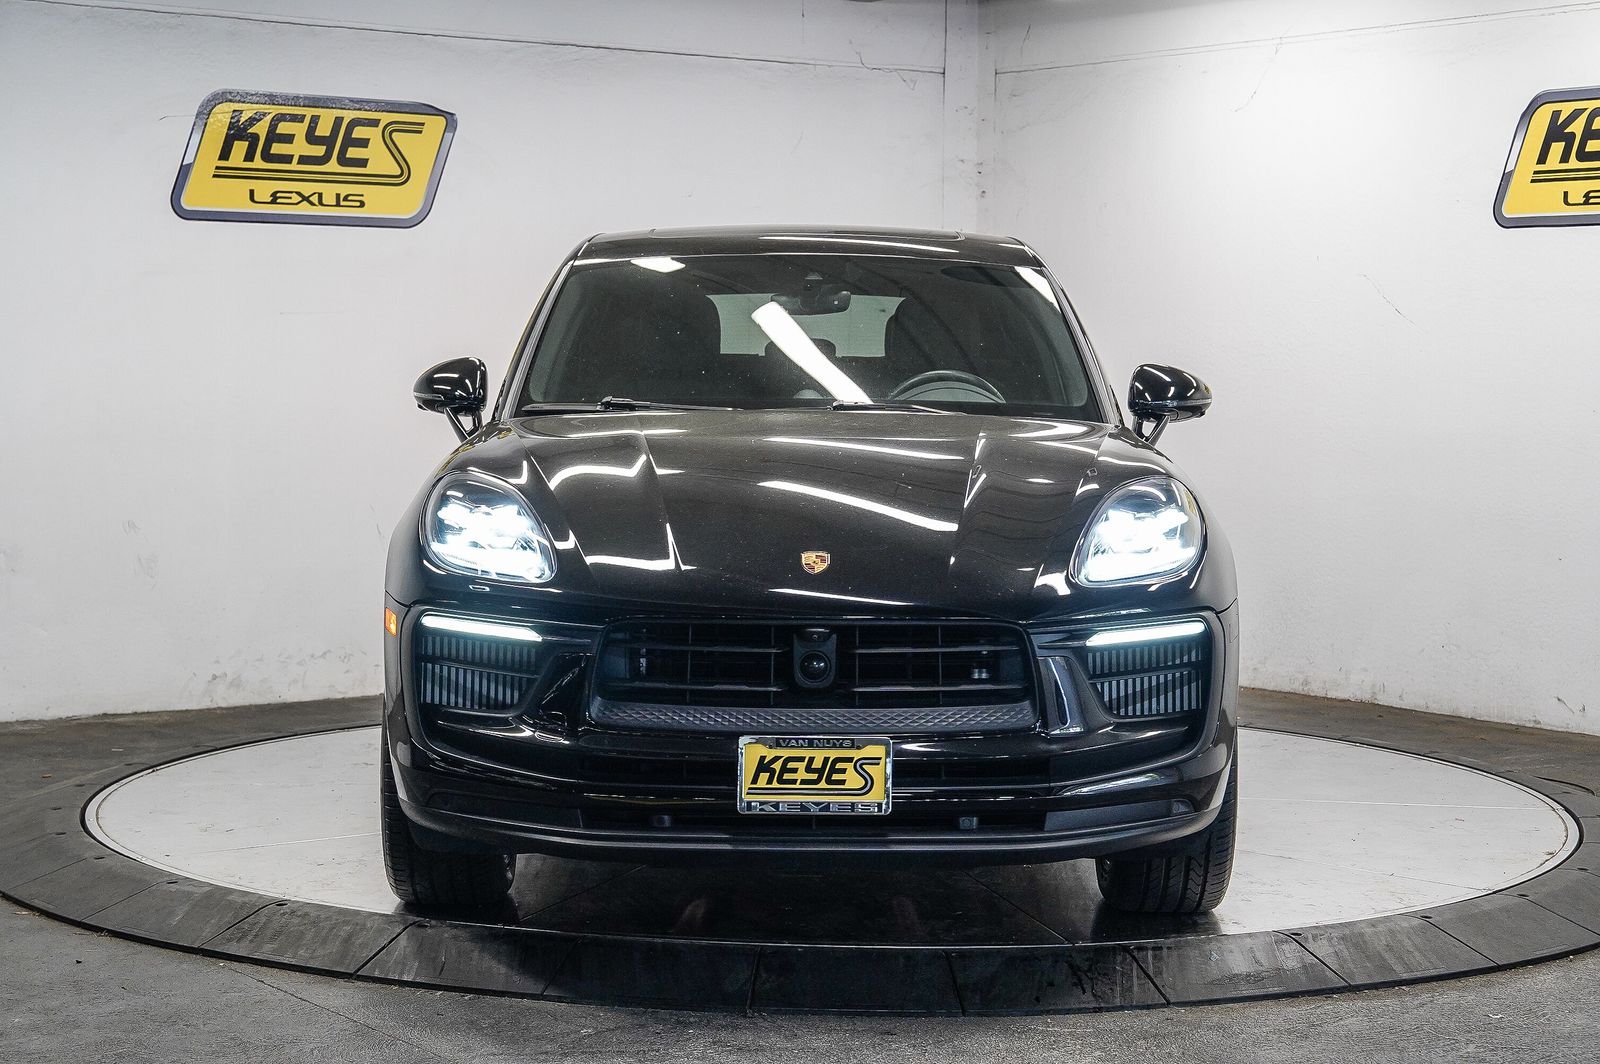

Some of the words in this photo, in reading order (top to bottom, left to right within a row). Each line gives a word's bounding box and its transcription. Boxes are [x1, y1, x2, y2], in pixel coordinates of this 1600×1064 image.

[213, 109, 425, 187] KEYES
[249, 188, 366, 209] LEXUS
[778, 739, 809, 748] VAN
[813, 739, 853, 748] NUYS
[746, 755, 883, 797] KEYES
[751, 802, 879, 813] KEYES
